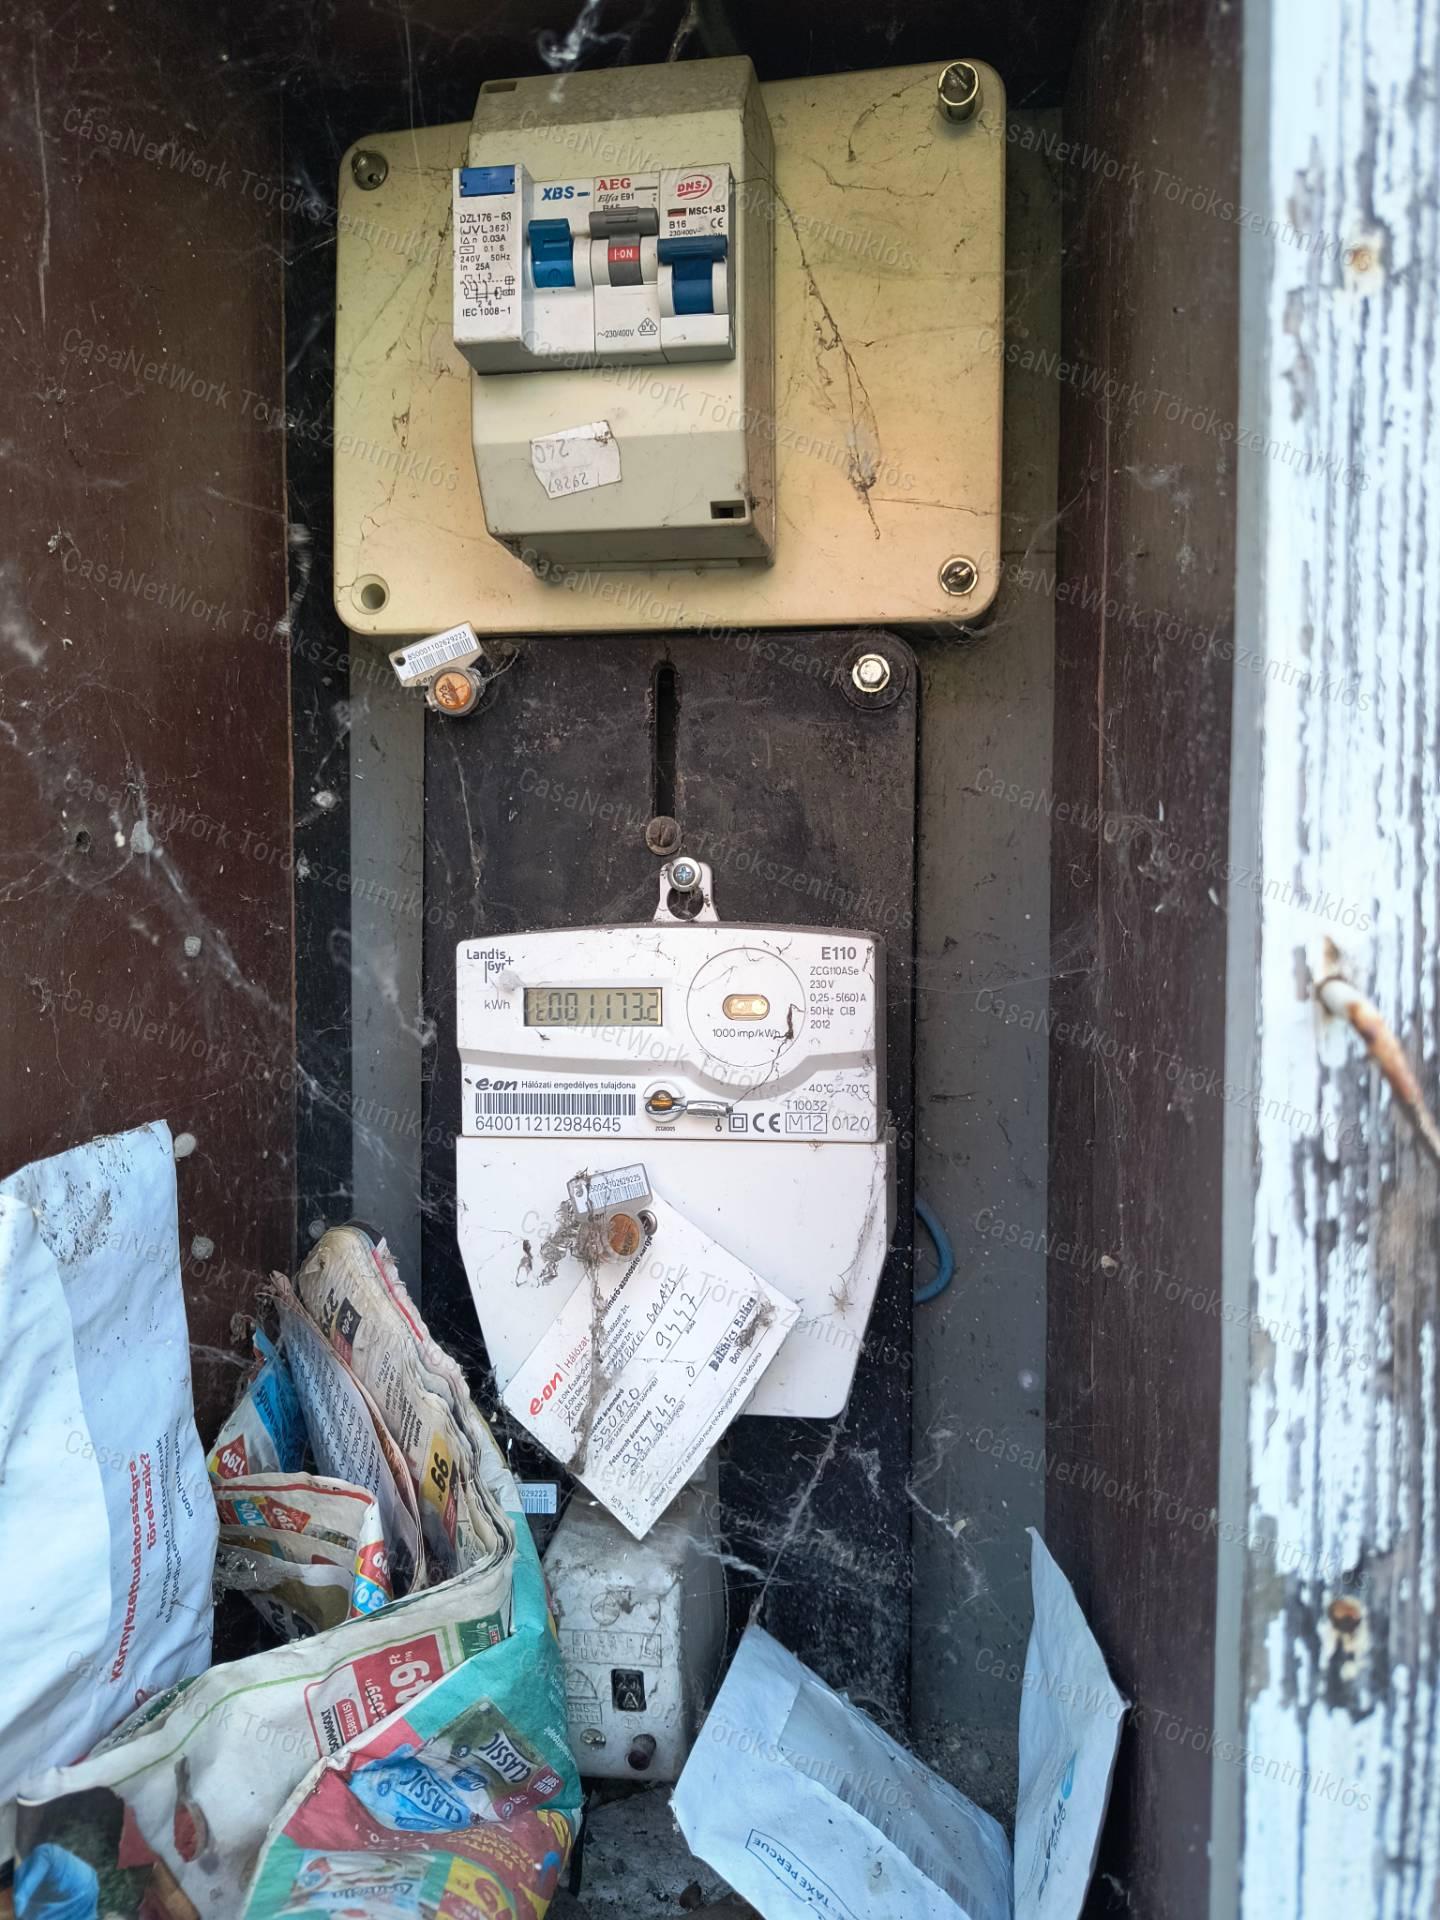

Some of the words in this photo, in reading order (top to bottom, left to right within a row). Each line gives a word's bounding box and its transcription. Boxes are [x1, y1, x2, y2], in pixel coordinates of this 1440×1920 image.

[596, 177, 632, 192] AEG
[541, 185, 575, 201] XBS
[620, 192, 635, 201] E91
[669, 220, 687, 229] B16
[459, 254, 481, 263] 240V
[490, 253, 511, 262] 50Hz
[475, 263, 490, 271] 25A
[462, 308, 478, 317] IEC
[821, 946, 857, 960] E110
[809, 980, 827, 989] 230
[484, 999, 511, 1010] kWh
[810, 1019, 831, 1030] 2012
[712, 1028, 736, 1039] 1000
[521, 1080, 552, 1090] Hálózati
[553, 1080, 599, 1091] engedélyes
[600, 1080, 636, 1091] tulajdona
[475, 1116, 622, 1133] 640011212984645
[788, 1114, 824, 1132] M12
[832, 1115, 870, 1131] 0120
[222, 1446, 247, 1477] 1299
[139, 1452, 158, 1551] törekszik?
[110, 1459, 143, 1684] Környezettudatosságra
[478, 1732, 533, 1784] CLASSIC
[398, 1768, 463, 1824] CLASSIC
